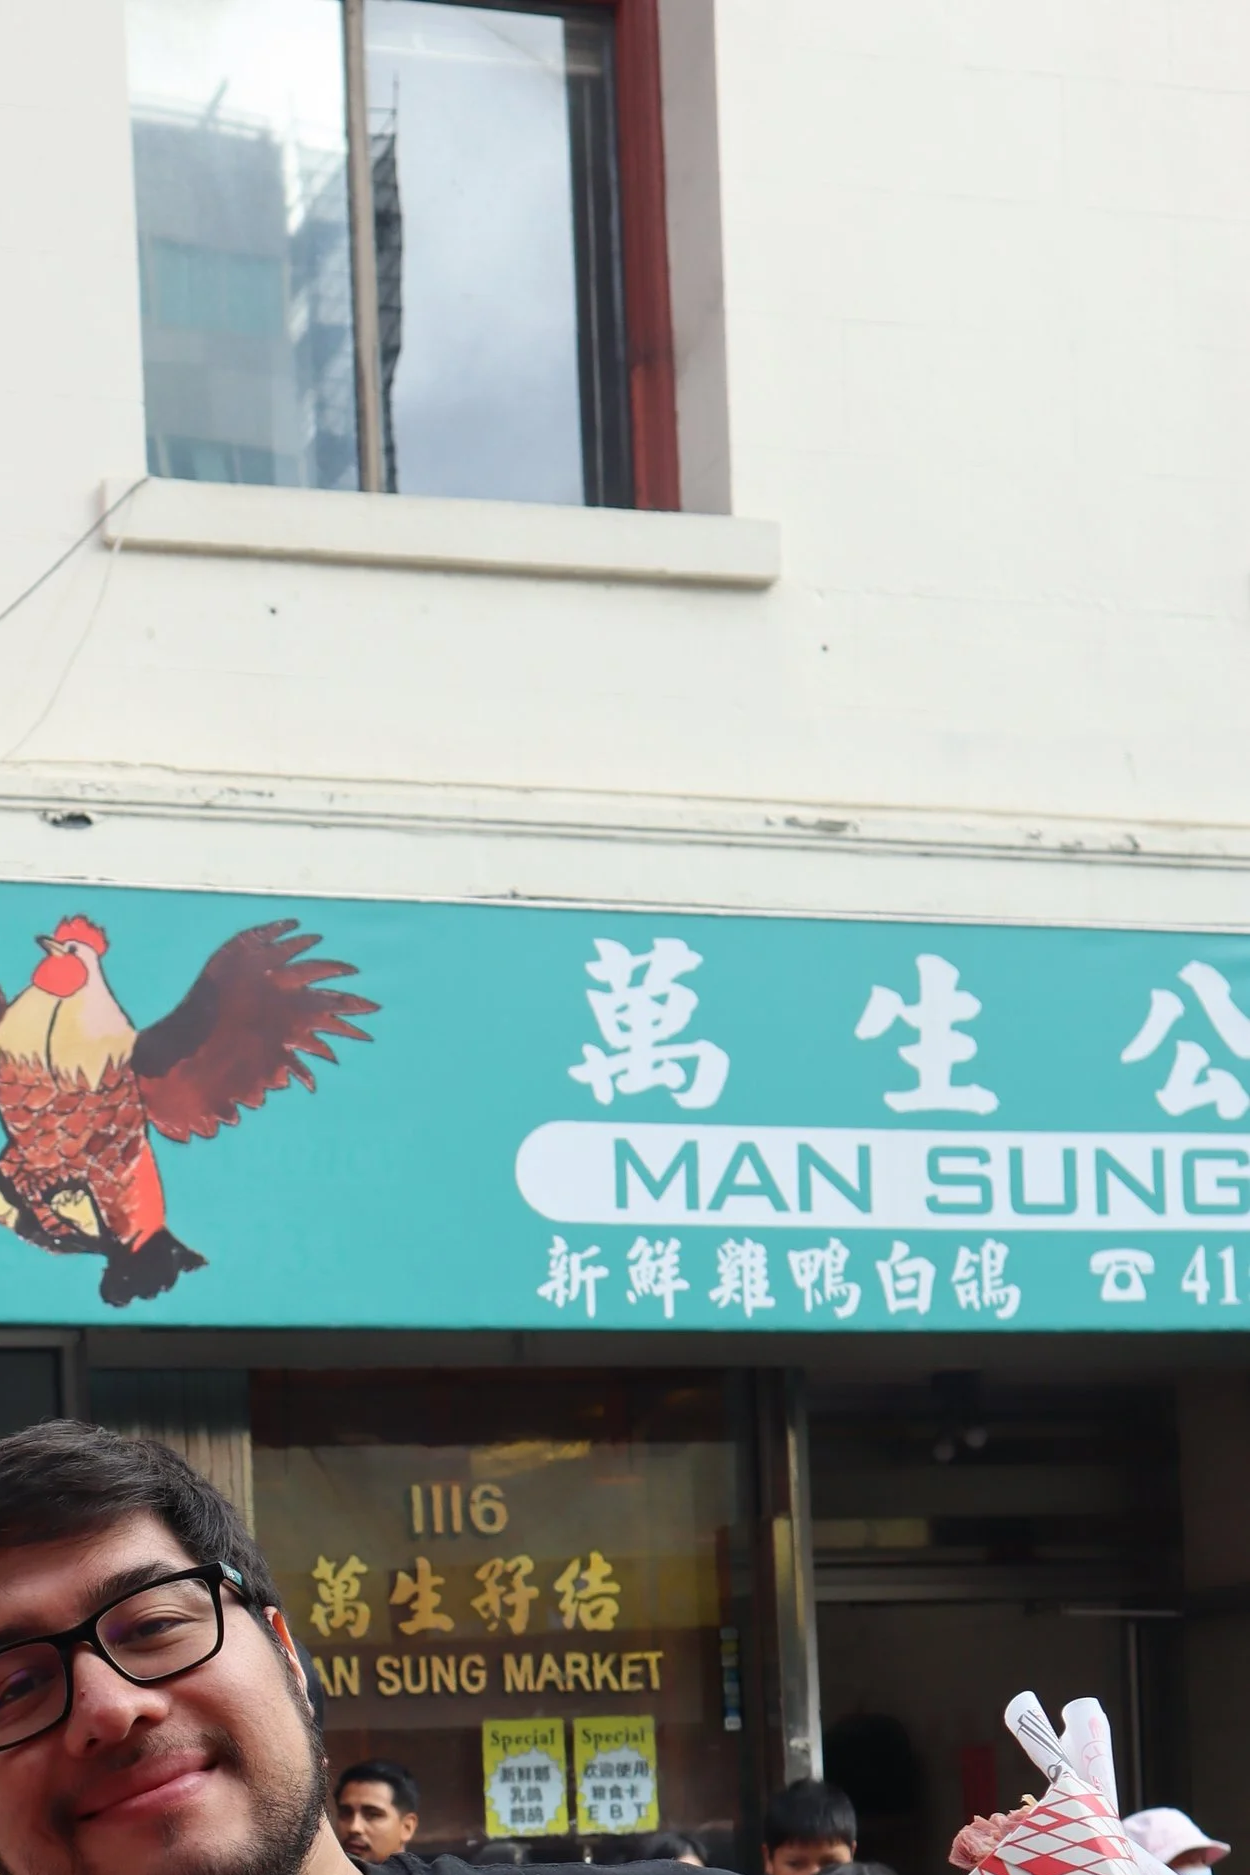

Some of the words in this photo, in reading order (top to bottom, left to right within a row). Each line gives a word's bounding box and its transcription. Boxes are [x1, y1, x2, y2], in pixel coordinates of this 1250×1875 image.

[613, 1137, 873, 1215] MAN
[925, 1145, 1250, 1216] SUNG
[1180, 1244, 1250, 1306] 41
[410, 1482, 510, 1536] 1116
[313, 1655, 361, 1698] AN
[376, 1654, 488, 1697] SUNG
[502, 1650, 665, 1694] MARKET
[490, 1727, 556, 1752] Special
[582, 1726, 646, 1751] Special
